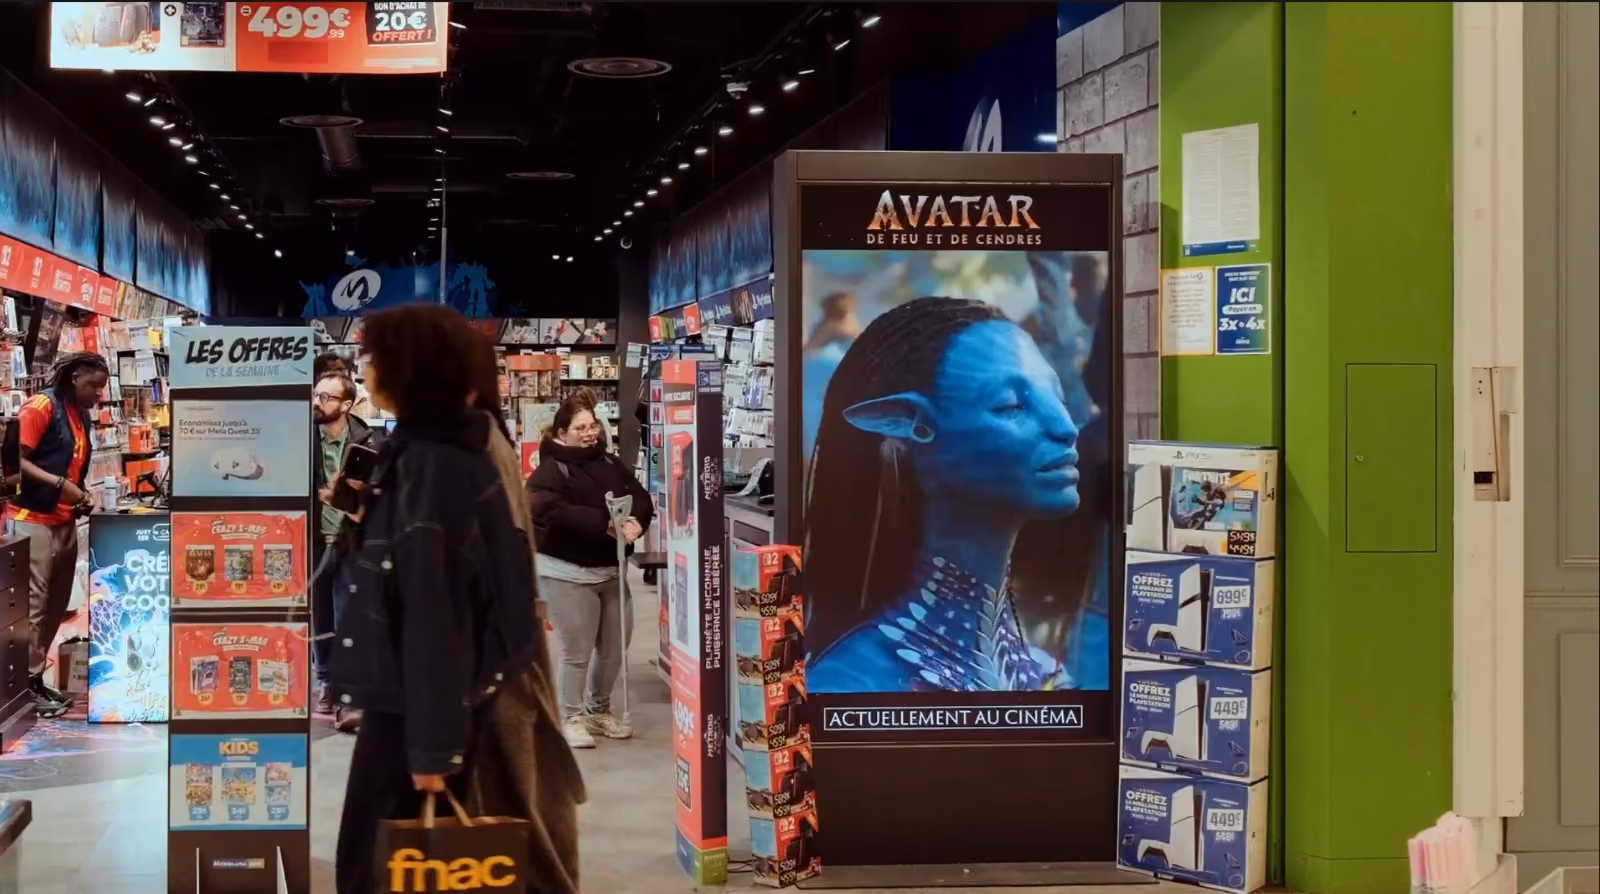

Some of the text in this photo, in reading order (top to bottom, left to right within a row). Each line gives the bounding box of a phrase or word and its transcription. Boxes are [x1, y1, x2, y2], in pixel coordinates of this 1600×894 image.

[375, 11, 427, 31] 20€
[372, 30, 423, 42] OFFERT
[866, 189, 1041, 231] AVATAR
[866, 233, 1041, 245] DE FEU ET DE CENDRES
[1229, 286, 1256, 303] ICI
[1218, 318, 1239, 331] 3x
[185, 336, 309, 364] LES OFFRES
[205, 366, 219, 377] DE
[221, 366, 232, 377] LA
[208, 427, 226, 435] Meta
[227, 427, 249, 435] Quest
[1132, 575, 1174, 588] OFFREZ
[712, 600, 721, 668] PUISSANCE
[1129, 683, 1171, 696] OFFREZ
[829, 706, 1078, 727] ACTUELLEMENT AU CINÉMA
[219, 741, 259, 755] KIDS
[1125, 790, 1168, 805] OFFREZ
[387, 848, 517, 893] fnac
